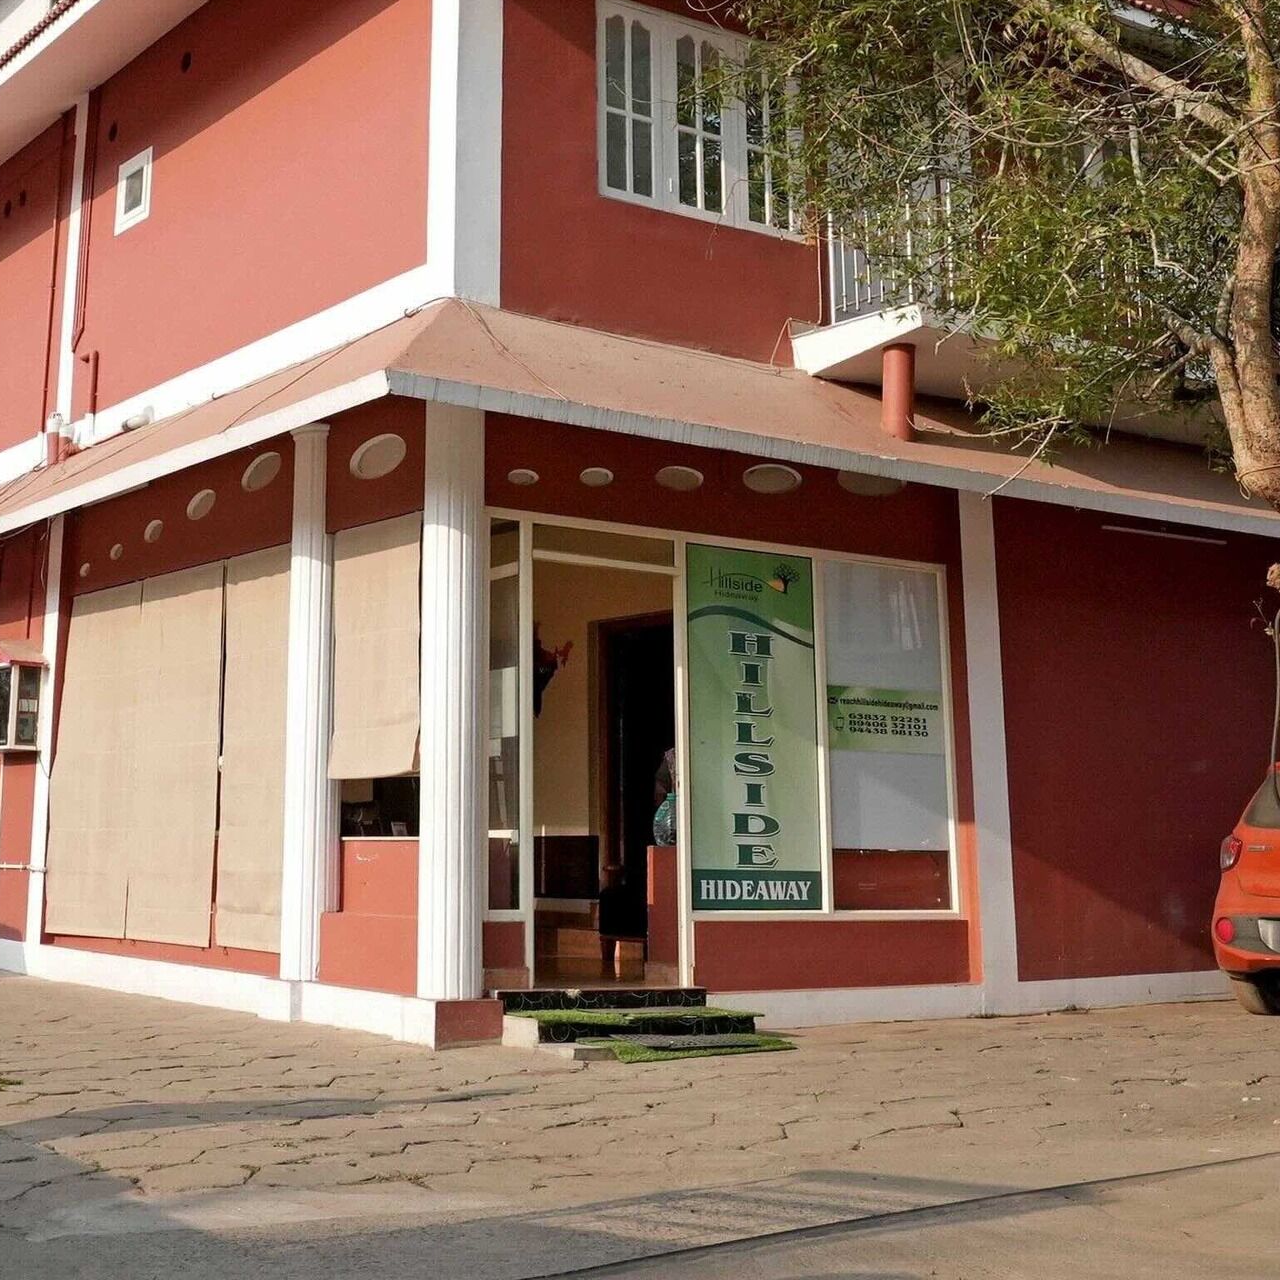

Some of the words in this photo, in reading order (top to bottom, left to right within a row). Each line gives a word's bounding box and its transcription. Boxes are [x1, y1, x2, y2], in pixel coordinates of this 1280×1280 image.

[703, 566, 763, 593] Hillside
[727, 630, 781, 869] HILLSIDE
[700, 879, 812, 901] HIDEAWAY
